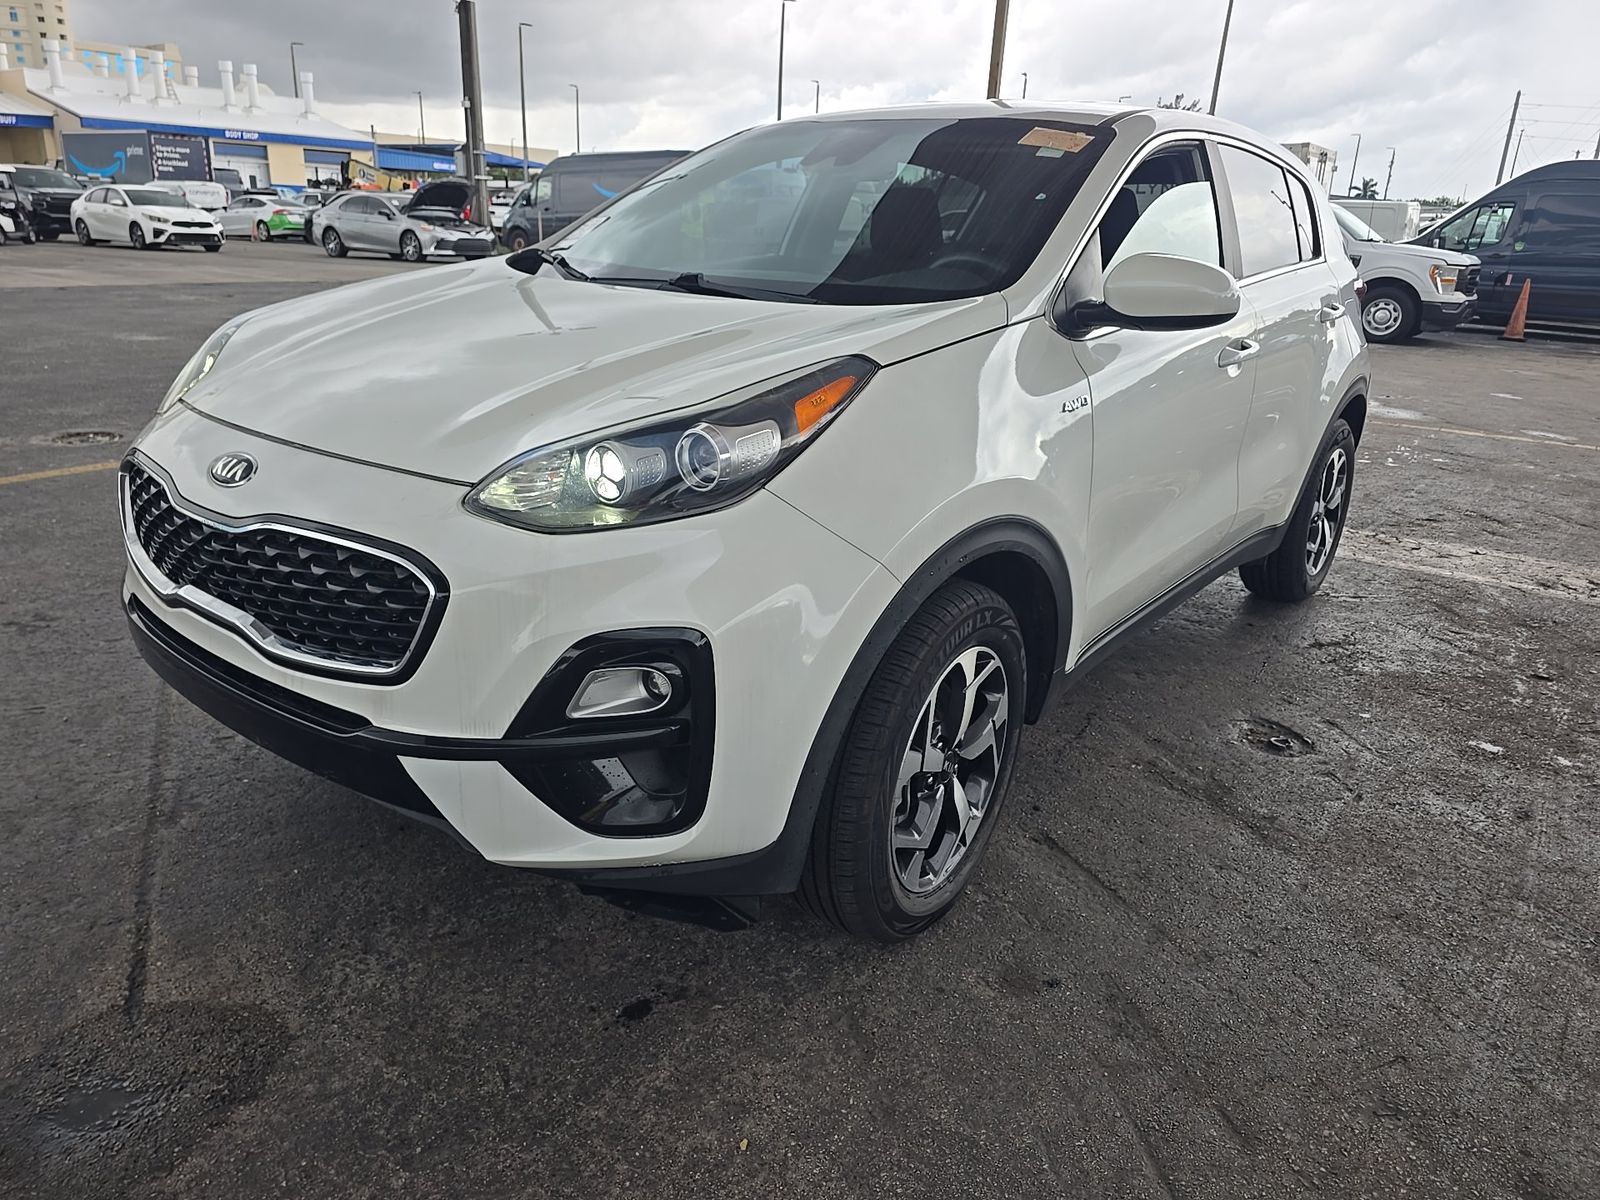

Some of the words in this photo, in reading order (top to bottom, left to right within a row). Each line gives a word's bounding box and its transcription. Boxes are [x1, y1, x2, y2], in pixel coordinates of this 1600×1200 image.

[224, 130, 241, 139] BODY
[242, 132, 259, 140] SHOP
[126, 144, 144, 157] prime
[1061, 395, 1089, 413] AWD
[212, 456, 248, 481] KIA
